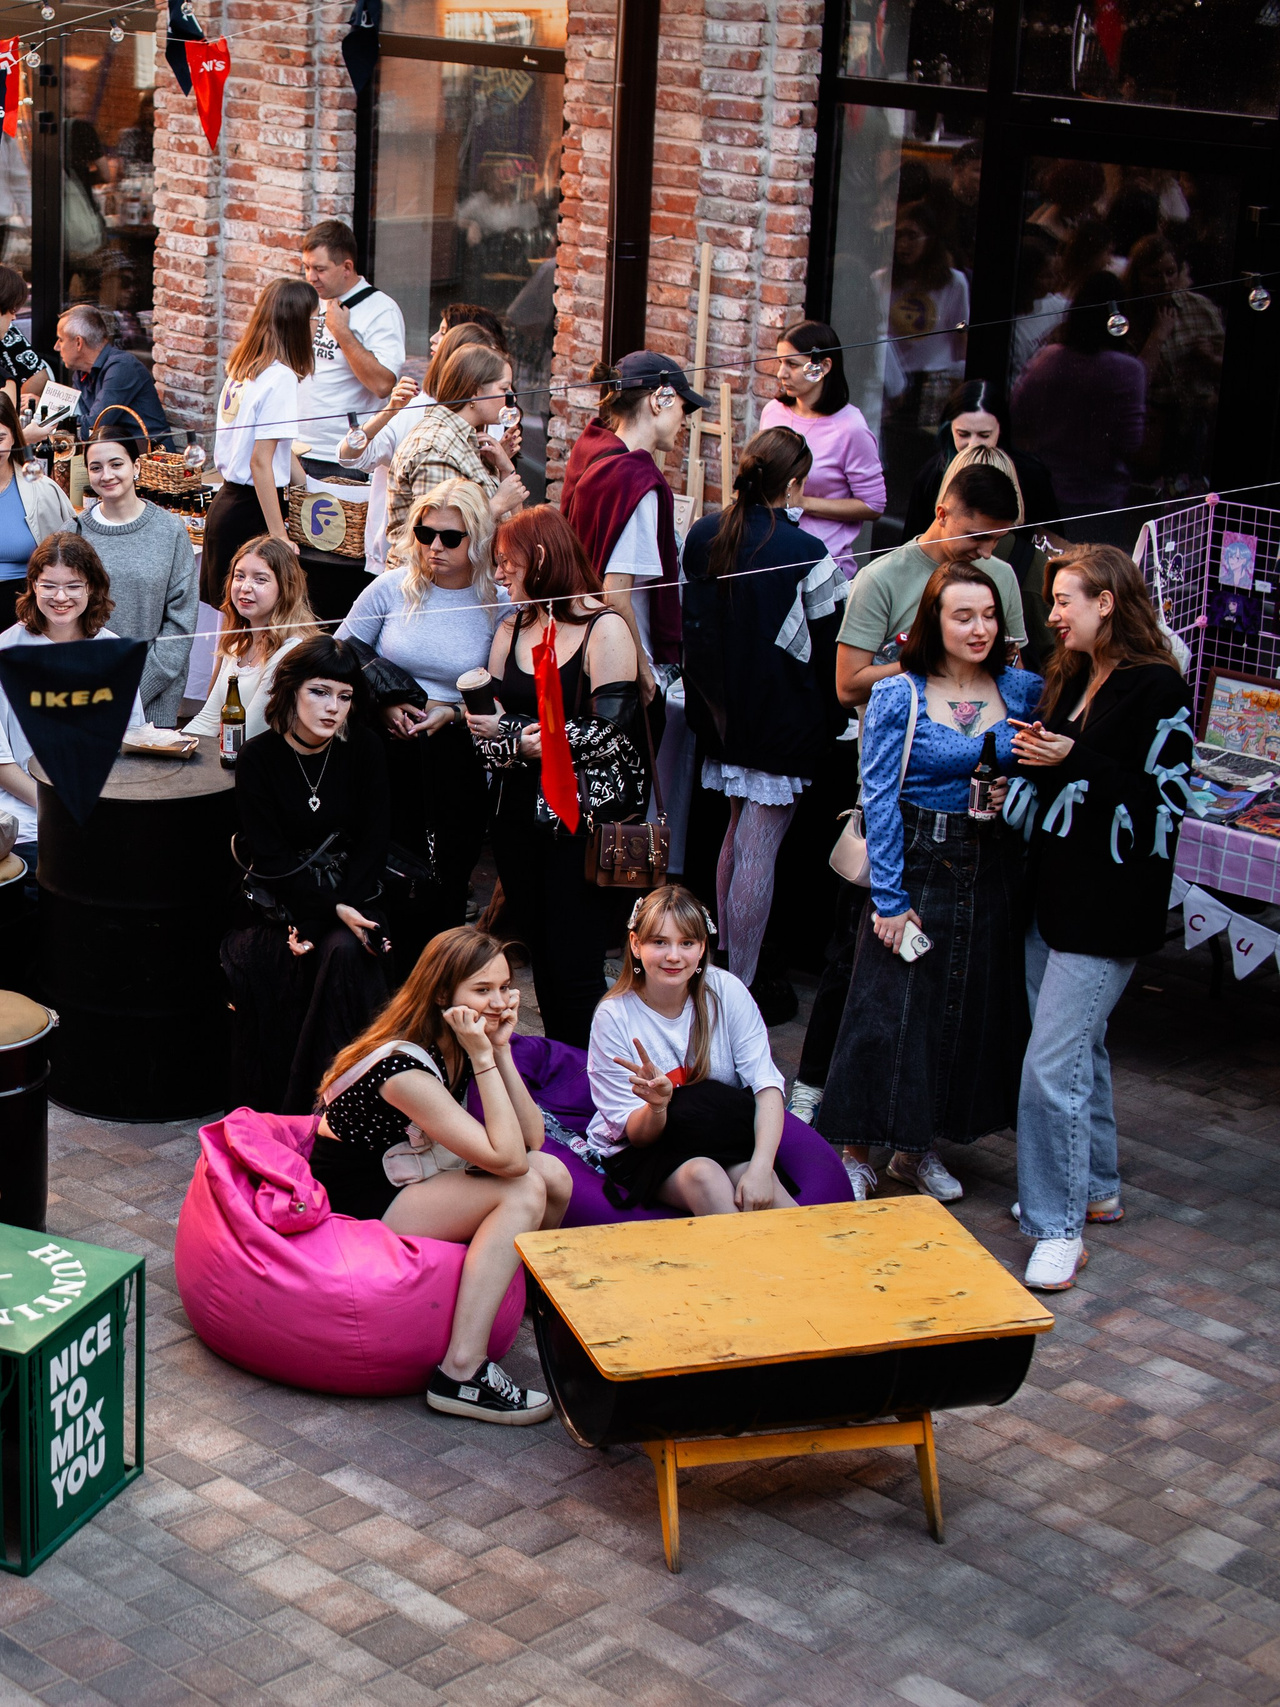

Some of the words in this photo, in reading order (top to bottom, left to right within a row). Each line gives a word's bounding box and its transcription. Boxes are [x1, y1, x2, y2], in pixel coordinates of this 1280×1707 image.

[30, 687, 113, 708] IKEA
[49, 1312, 112, 1396] NICE
[50, 1375, 89, 1432] TO
[50, 1396, 106, 1475] MIX
[50, 1433, 106, 1510] YOU
